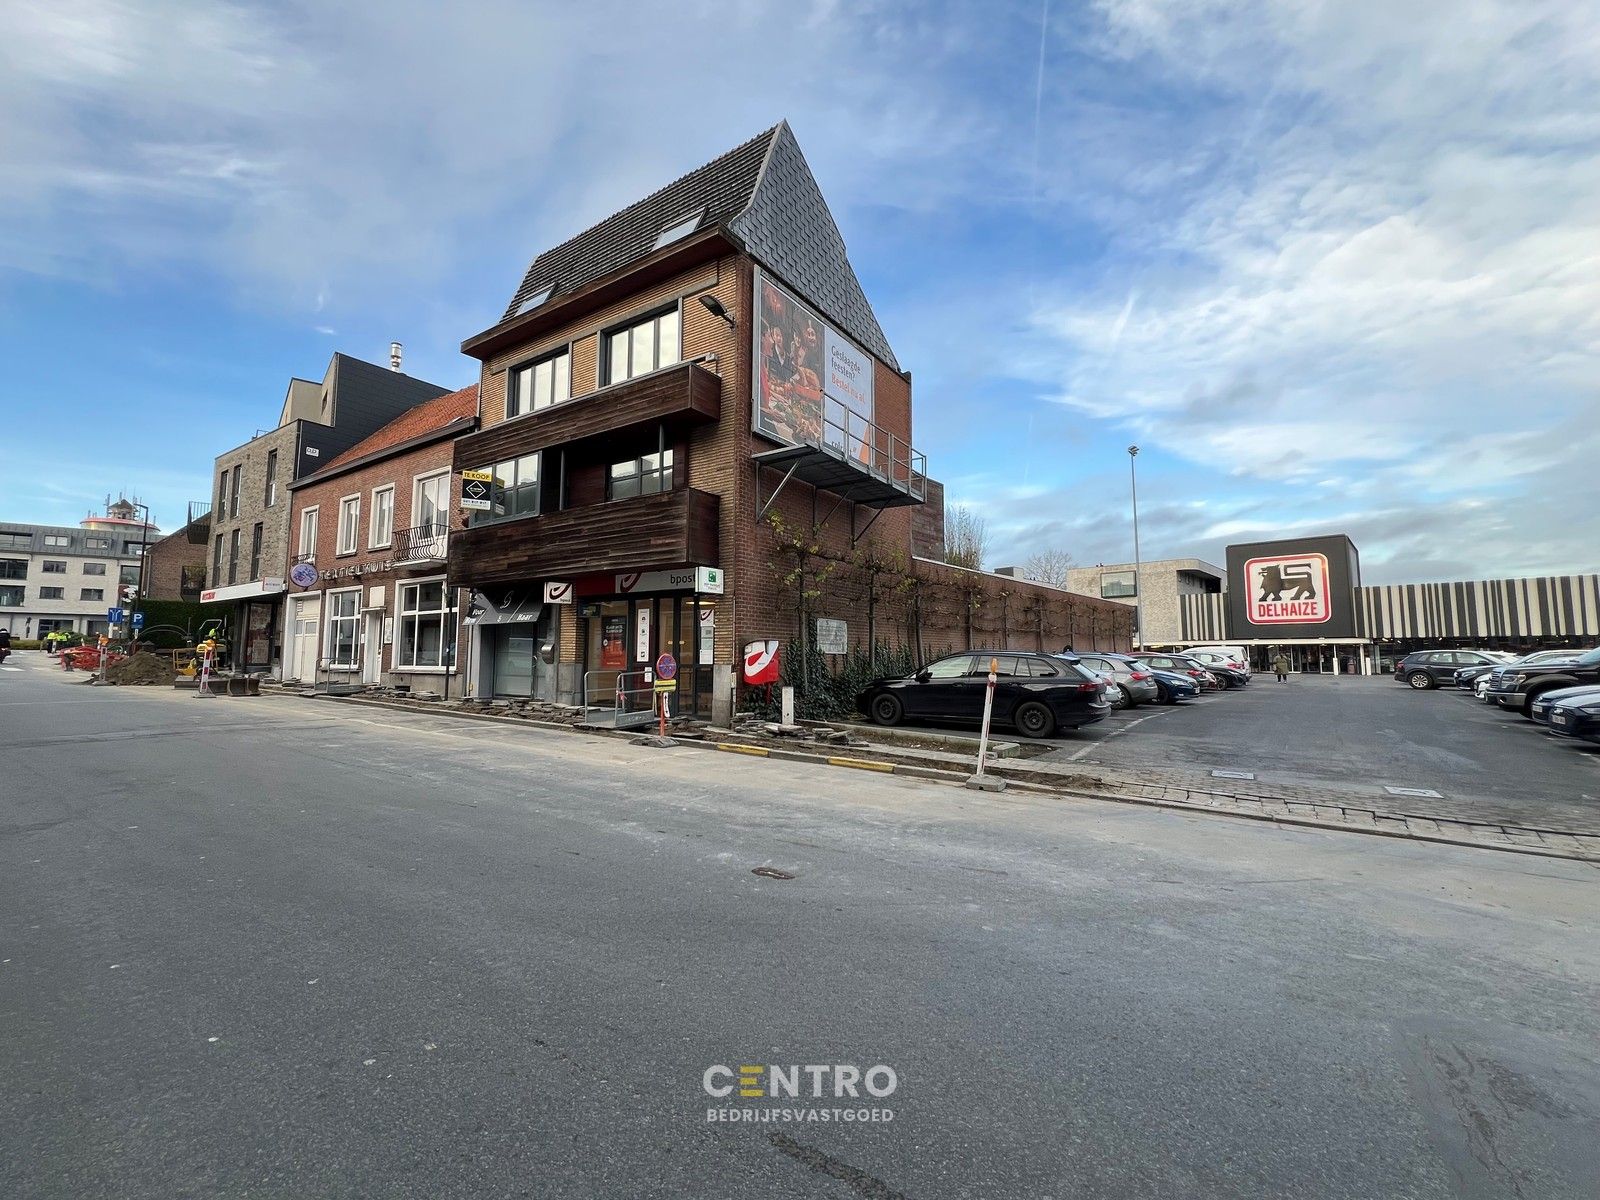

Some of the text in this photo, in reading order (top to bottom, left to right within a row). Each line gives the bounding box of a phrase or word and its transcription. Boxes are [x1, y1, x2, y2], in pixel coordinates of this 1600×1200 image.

[831, 345, 861, 375] Geslaagde
[831, 357, 855, 383] feesten?
[670, 574, 696, 586] bpost
[1258, 602, 1318, 617] DELHAIZE
[133, 613, 142, 623] P
